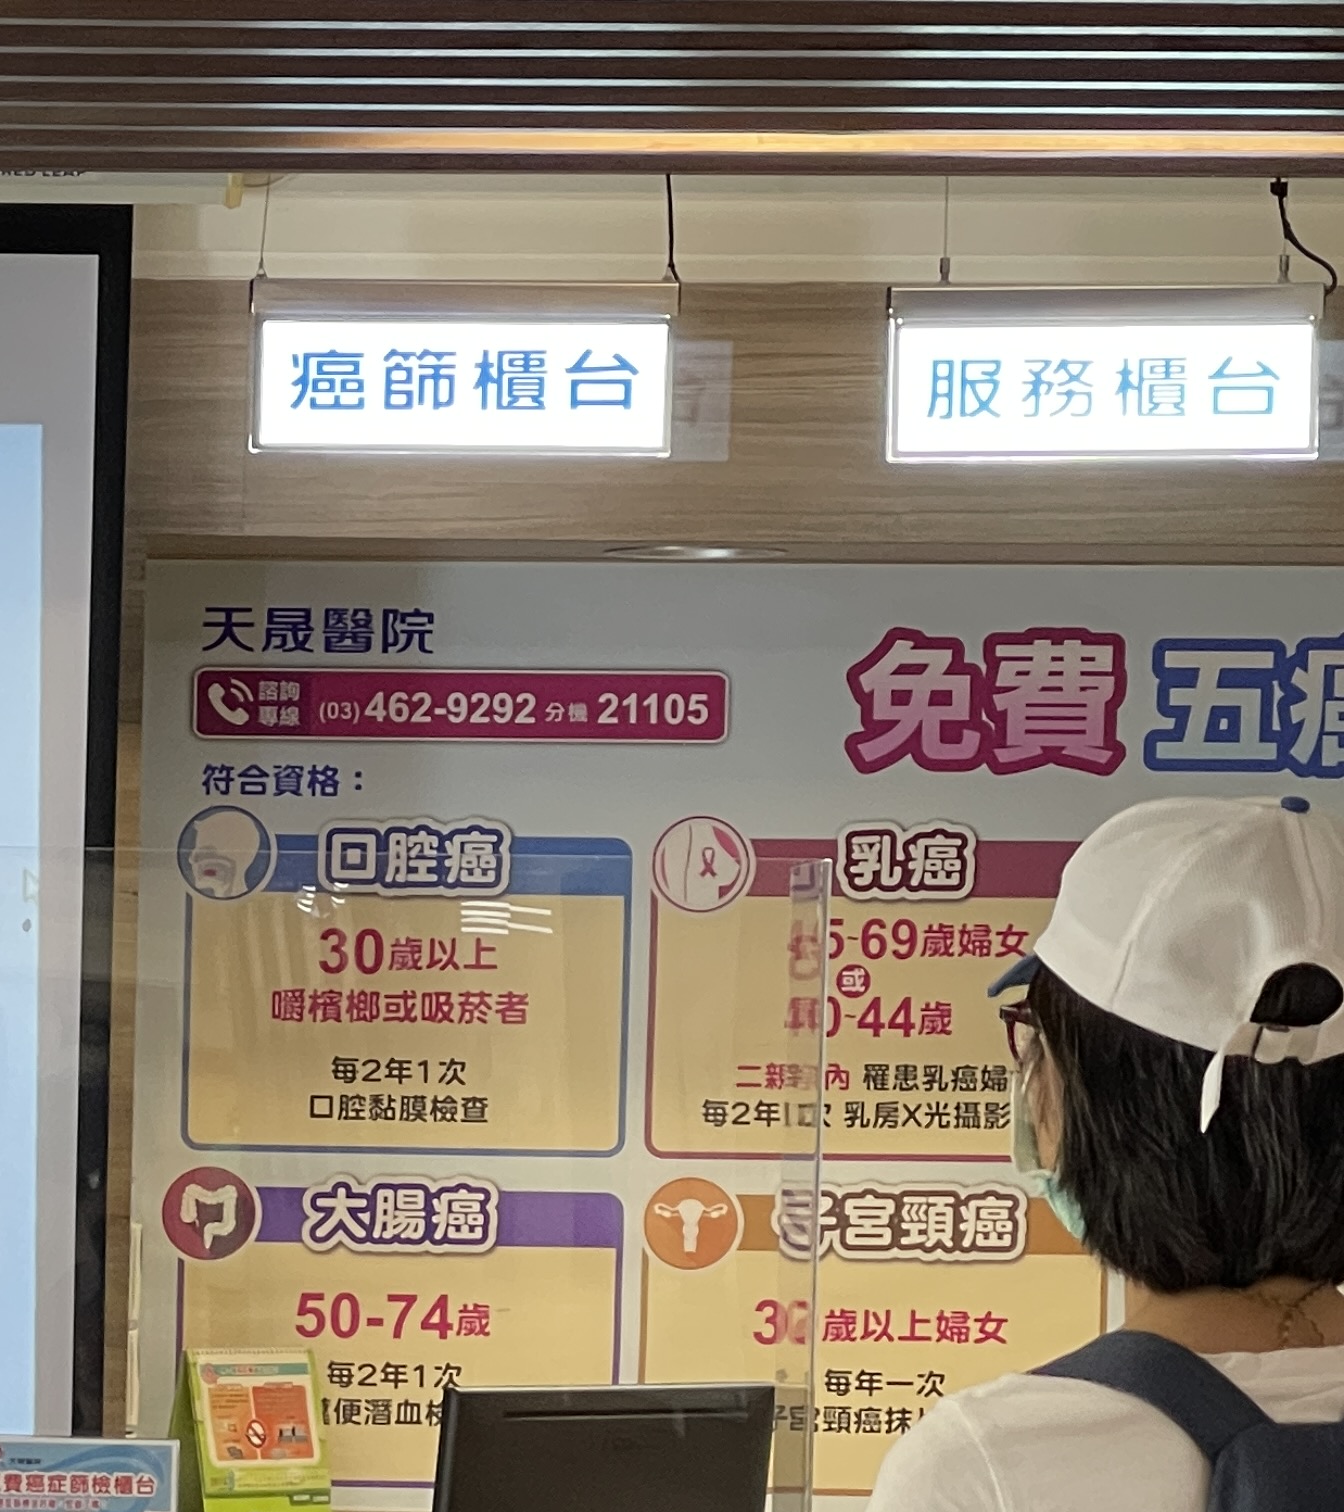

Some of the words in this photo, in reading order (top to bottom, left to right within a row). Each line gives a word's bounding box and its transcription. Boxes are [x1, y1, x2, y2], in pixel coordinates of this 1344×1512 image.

[290, 348, 642, 413] 癌篩櫃台
[925, 357, 1283, 421] 服務櫃台
[201, 606, 436, 655] 天晟醫院
[544, 702, 589, 725] 分機
[596, 693, 711, 726] 21105
[850, 633, 1120, 771] 免費
[201, 763, 364, 798] 符合資格：
[843, 832, 970, 888] 乳癌
[317, 927, 499, 975] 30歲以上
[270, 988, 530, 1026] 嚼檳榔或吸菸者
[330, 1056, 468, 1087] 每2年1次
[863, 1063, 1015, 1092] 罹患乳癌婦
[308, 1093, 489, 1124] 口腔黏膜檢查
[844, 1100, 1011, 1130] 乳房X光攝影
[312, 1184, 489, 1243] 大腸癌
[295, 1291, 492, 1341] 50-74歲
[327, 1360, 463, 1390] 每2年1次
[824, 1367, 946, 1398] 每年一次
